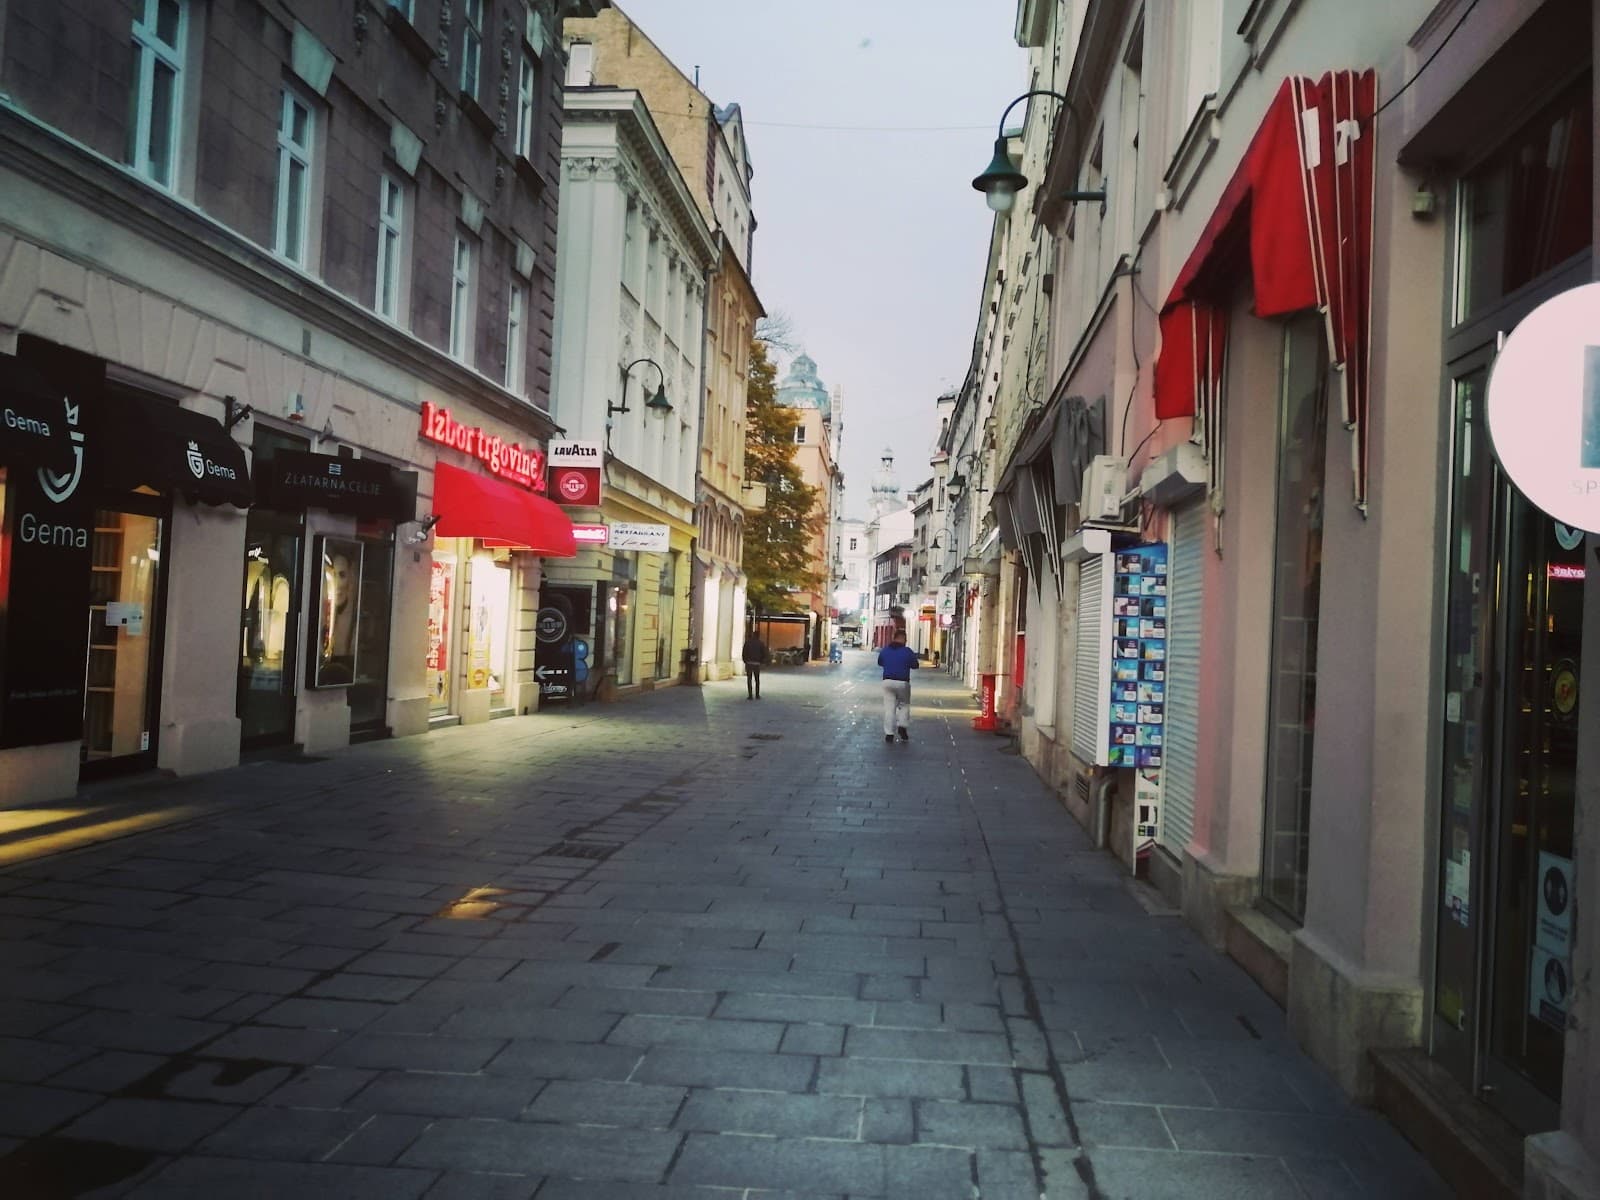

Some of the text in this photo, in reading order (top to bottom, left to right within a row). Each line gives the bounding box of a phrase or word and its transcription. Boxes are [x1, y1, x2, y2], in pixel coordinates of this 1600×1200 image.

[4, 408, 51, 437] Gema
[425, 401, 473, 453] Izbor
[478, 428, 538, 481] trgovine
[206, 459, 236, 480] Gema
[284, 472, 346, 490] ZLATARNA
[20, 512, 88, 549] Gema
